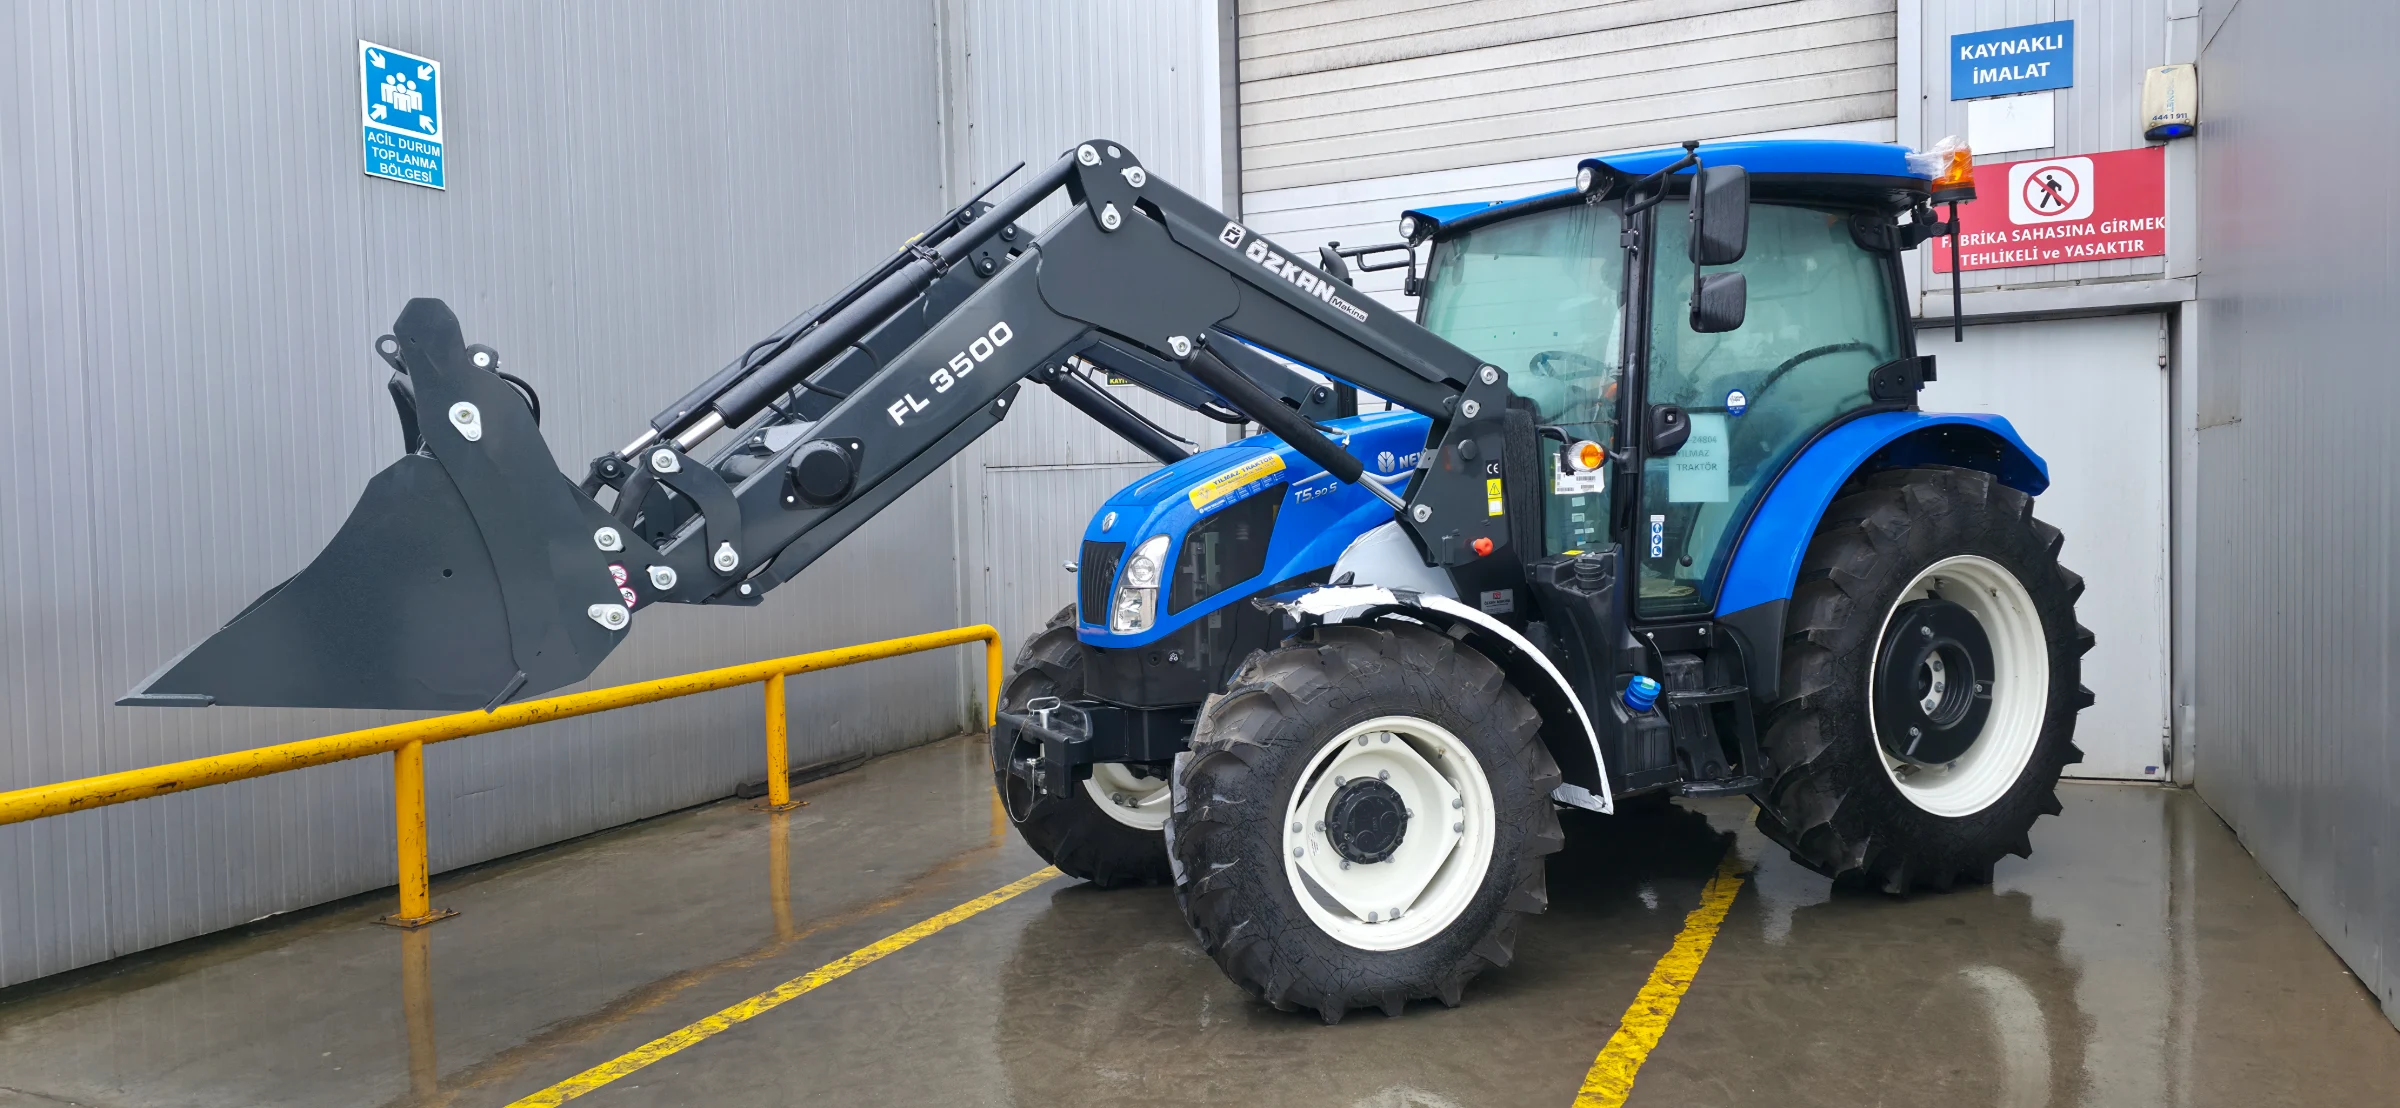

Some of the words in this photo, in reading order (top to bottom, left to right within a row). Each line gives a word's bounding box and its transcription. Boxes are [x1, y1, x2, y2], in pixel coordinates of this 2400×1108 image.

[1960, 34, 2063, 61] KAYNAKLI
[1973, 62, 2051, 84] İMALAT
[367, 131, 395, 147] ACİL
[398, 138, 441, 157] DURUM
[372, 146, 438, 170] TOPLANMA
[380, 163, 432, 183] BÖLGESİ
[1941, 230, 2007, 248] FBRİKA
[2011, 223, 2096, 243] SAHASINA
[2100, 216, 2166, 233] GİRMEK
[1960, 245, 2039, 267] TEHLİKELİ
[2042, 249, 2060, 260] ve
[2064, 239, 2145, 258] YASAKTIR
[1245, 238, 1336, 303] ÖZKAN
[1331, 297, 1366, 321] Makina
[887, 393, 931, 427] FL
[929, 321, 1013, 393] 3500
[1486, 463, 1499, 474] CE
[1676, 461, 1718, 472] TRAKTÖR
[1329, 481, 1338, 493] S
